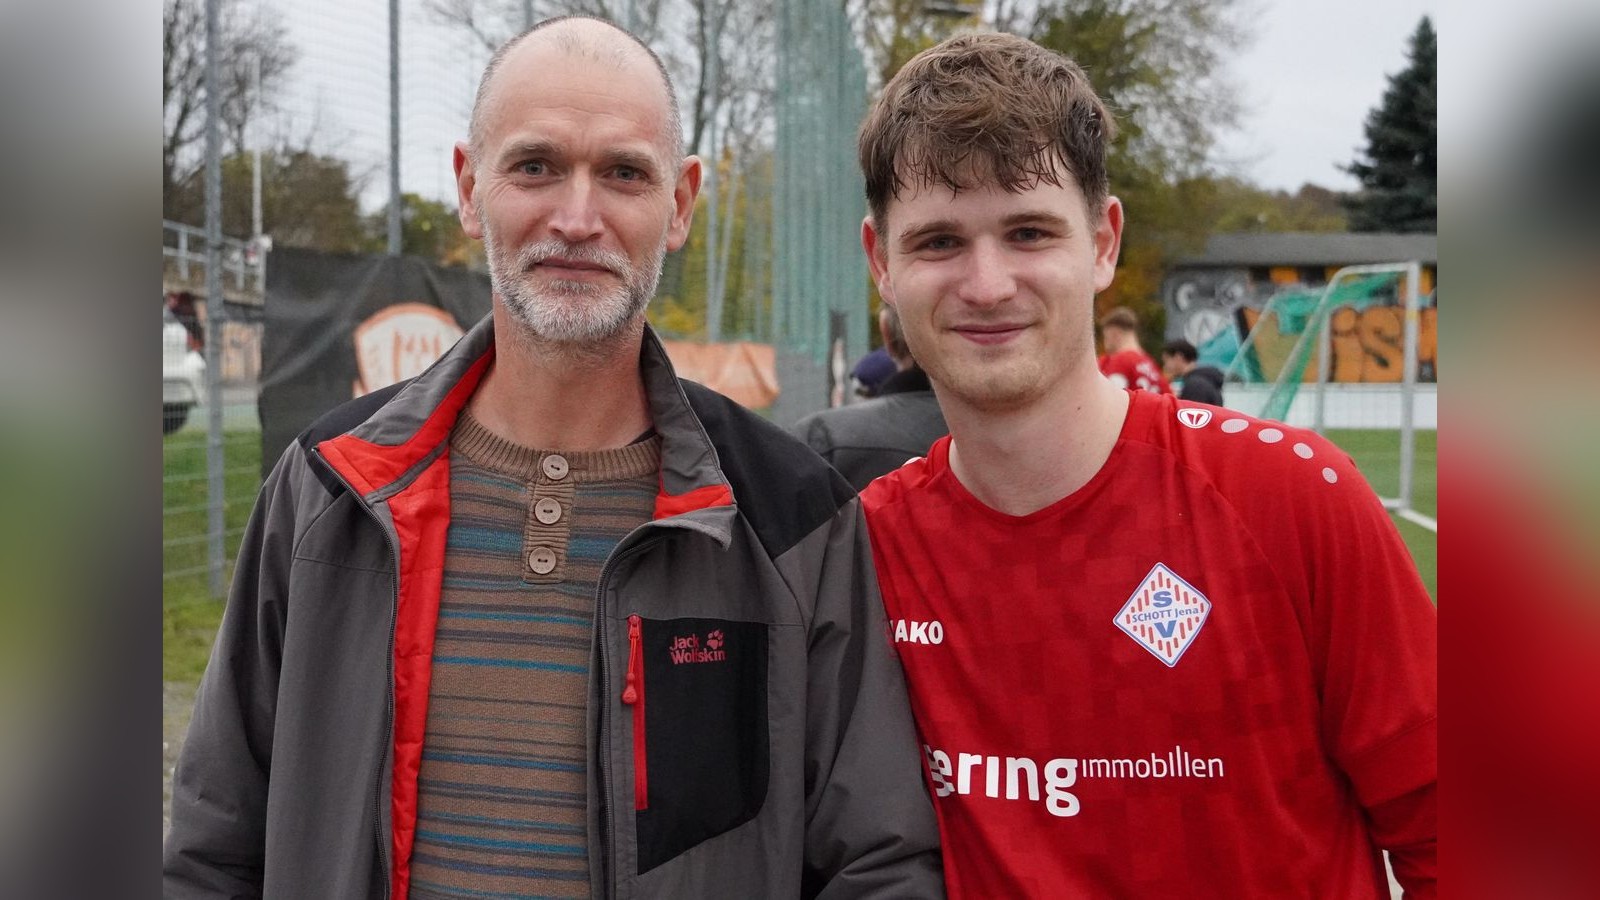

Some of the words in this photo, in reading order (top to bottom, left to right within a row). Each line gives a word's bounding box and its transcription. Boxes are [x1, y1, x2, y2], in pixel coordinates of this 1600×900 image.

[1153, 591, 1172, 607] S
[1132, 609, 1172, 622] SCHOTT
[1174, 607, 1199, 618] Jena
[889, 619, 944, 645] AKO
[1154, 620, 1177, 638] V
[669, 633, 700, 651] Jack
[670, 648, 726, 664] Wolfskin
[1082, 745, 1224, 778] immobilien
